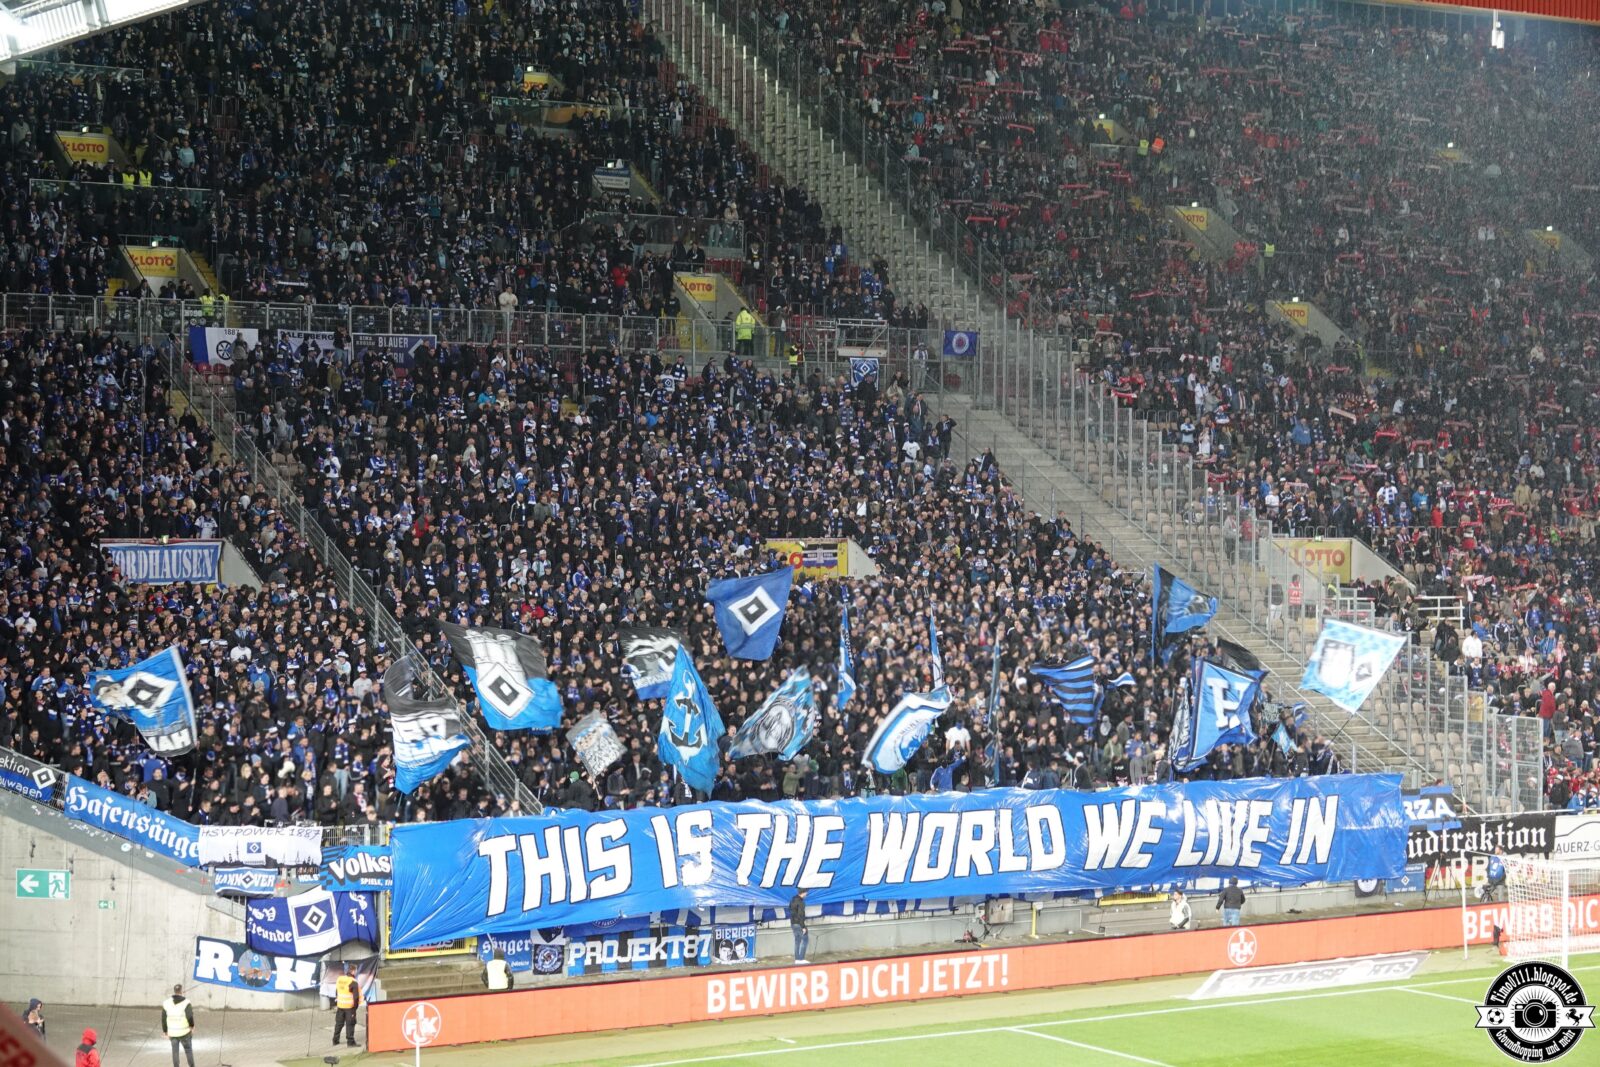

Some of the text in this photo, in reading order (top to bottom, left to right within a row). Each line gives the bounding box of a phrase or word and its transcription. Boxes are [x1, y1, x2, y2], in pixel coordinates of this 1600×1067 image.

[72, 143, 105, 153] LOTTO
[139, 254, 174, 267] LOTTO
[378, 336, 409, 349] BLAUER
[1294, 548, 1346, 568] LOTTO
[202, 827, 320, 840] HSV-POWER 1887
[328, 852, 392, 881] Volks
[479, 794, 1339, 918] THIS IS THE WORLD WE LIVE IN
[1465, 902, 1554, 941] BEWIRB
[567, 934, 712, 967] PROJEKT87
[707, 953, 1009, 1015] BEWIRB DICH JETZT!
